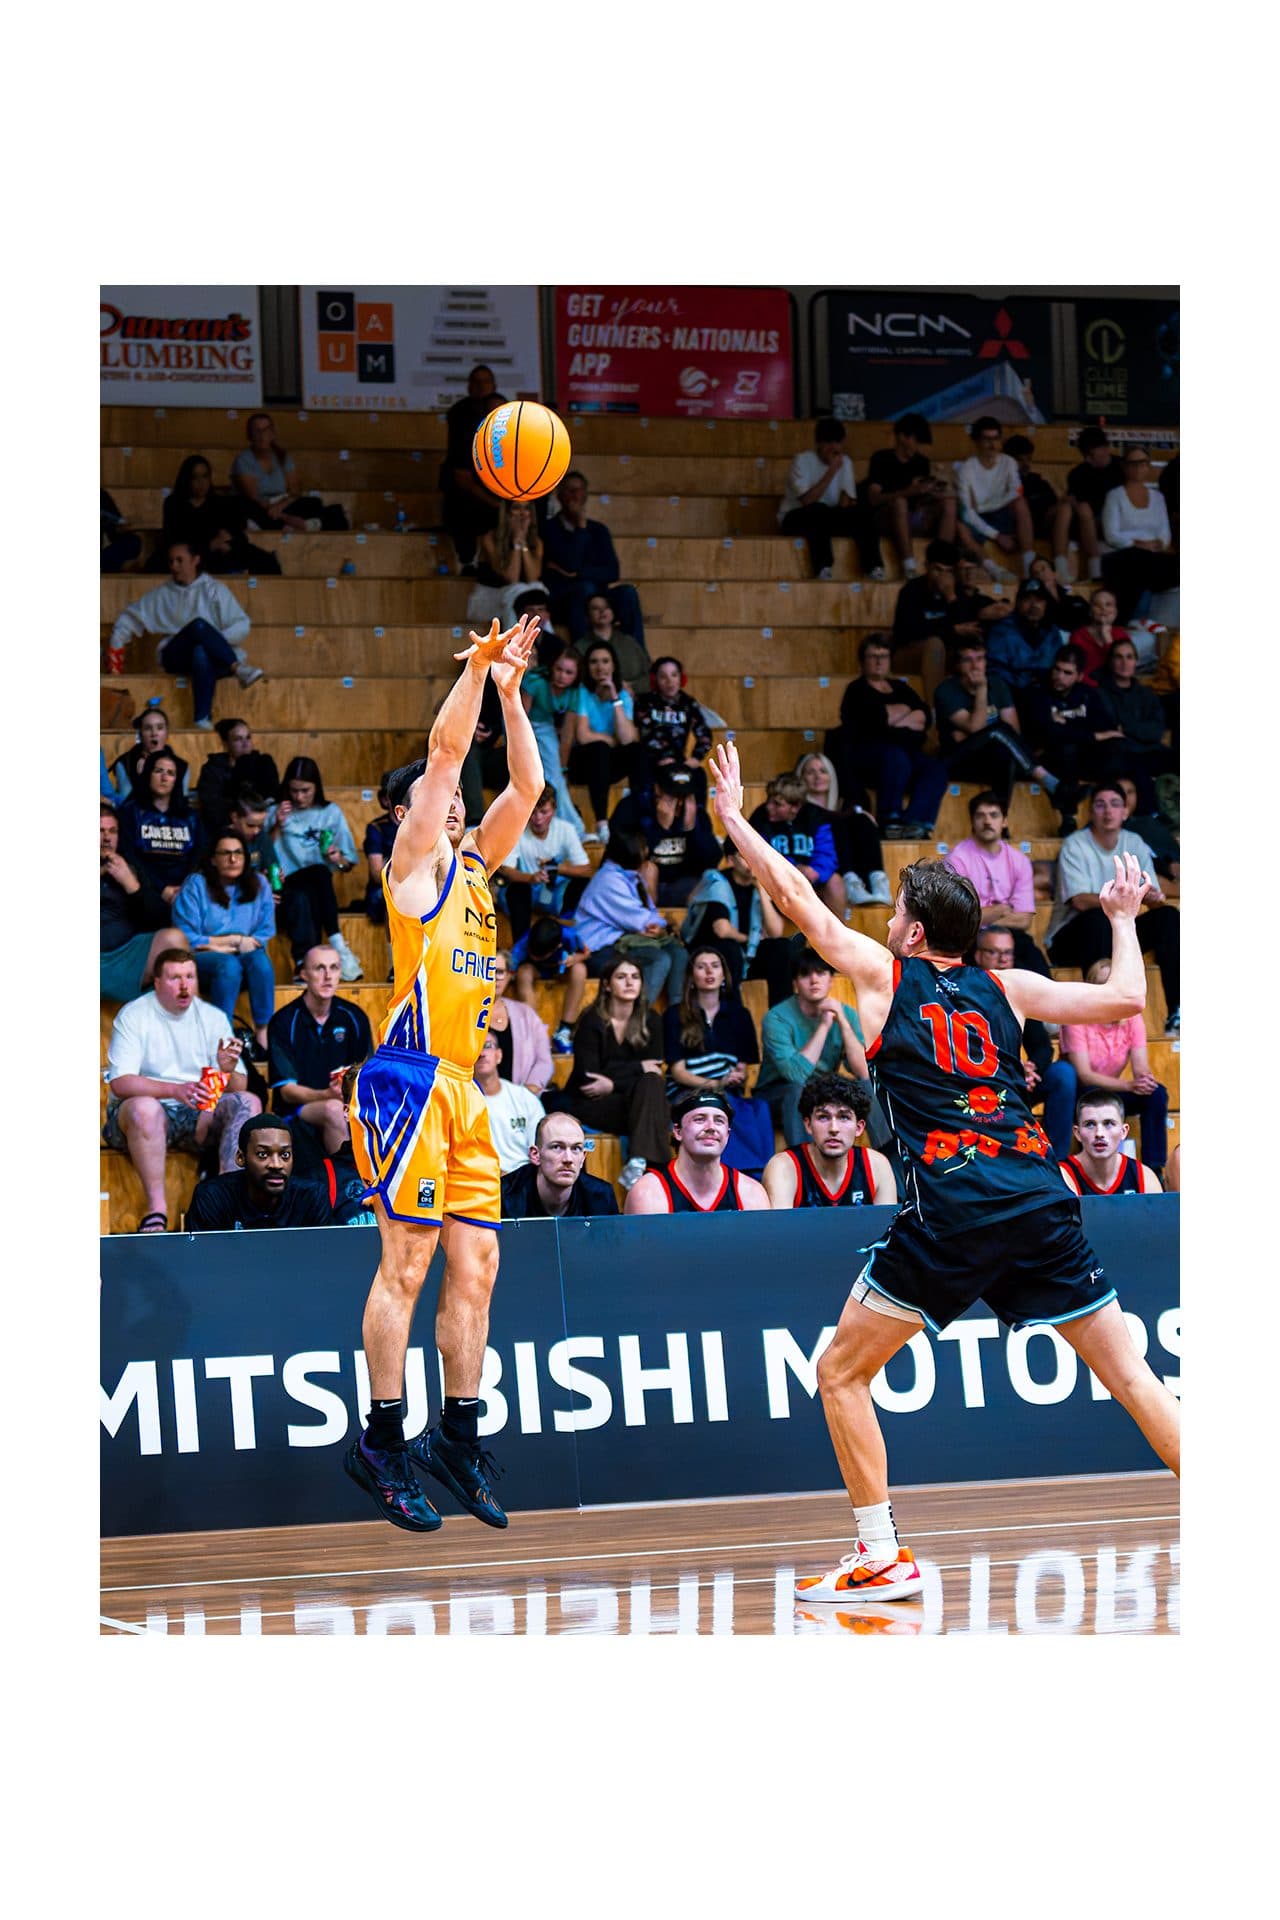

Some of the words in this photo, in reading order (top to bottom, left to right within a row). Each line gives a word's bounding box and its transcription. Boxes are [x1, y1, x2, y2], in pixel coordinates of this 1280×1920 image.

[567, 293, 605, 318] GET
[611, 296, 687, 325] your
[567, 322, 662, 350] GUNNERS
[672, 327, 780, 353] NATIONALS
[848, 312, 972, 339] NCM
[100, 342, 254, 370] LUMBING
[568, 352, 612, 377] APP
[919, 1001, 1000, 1079] 10
